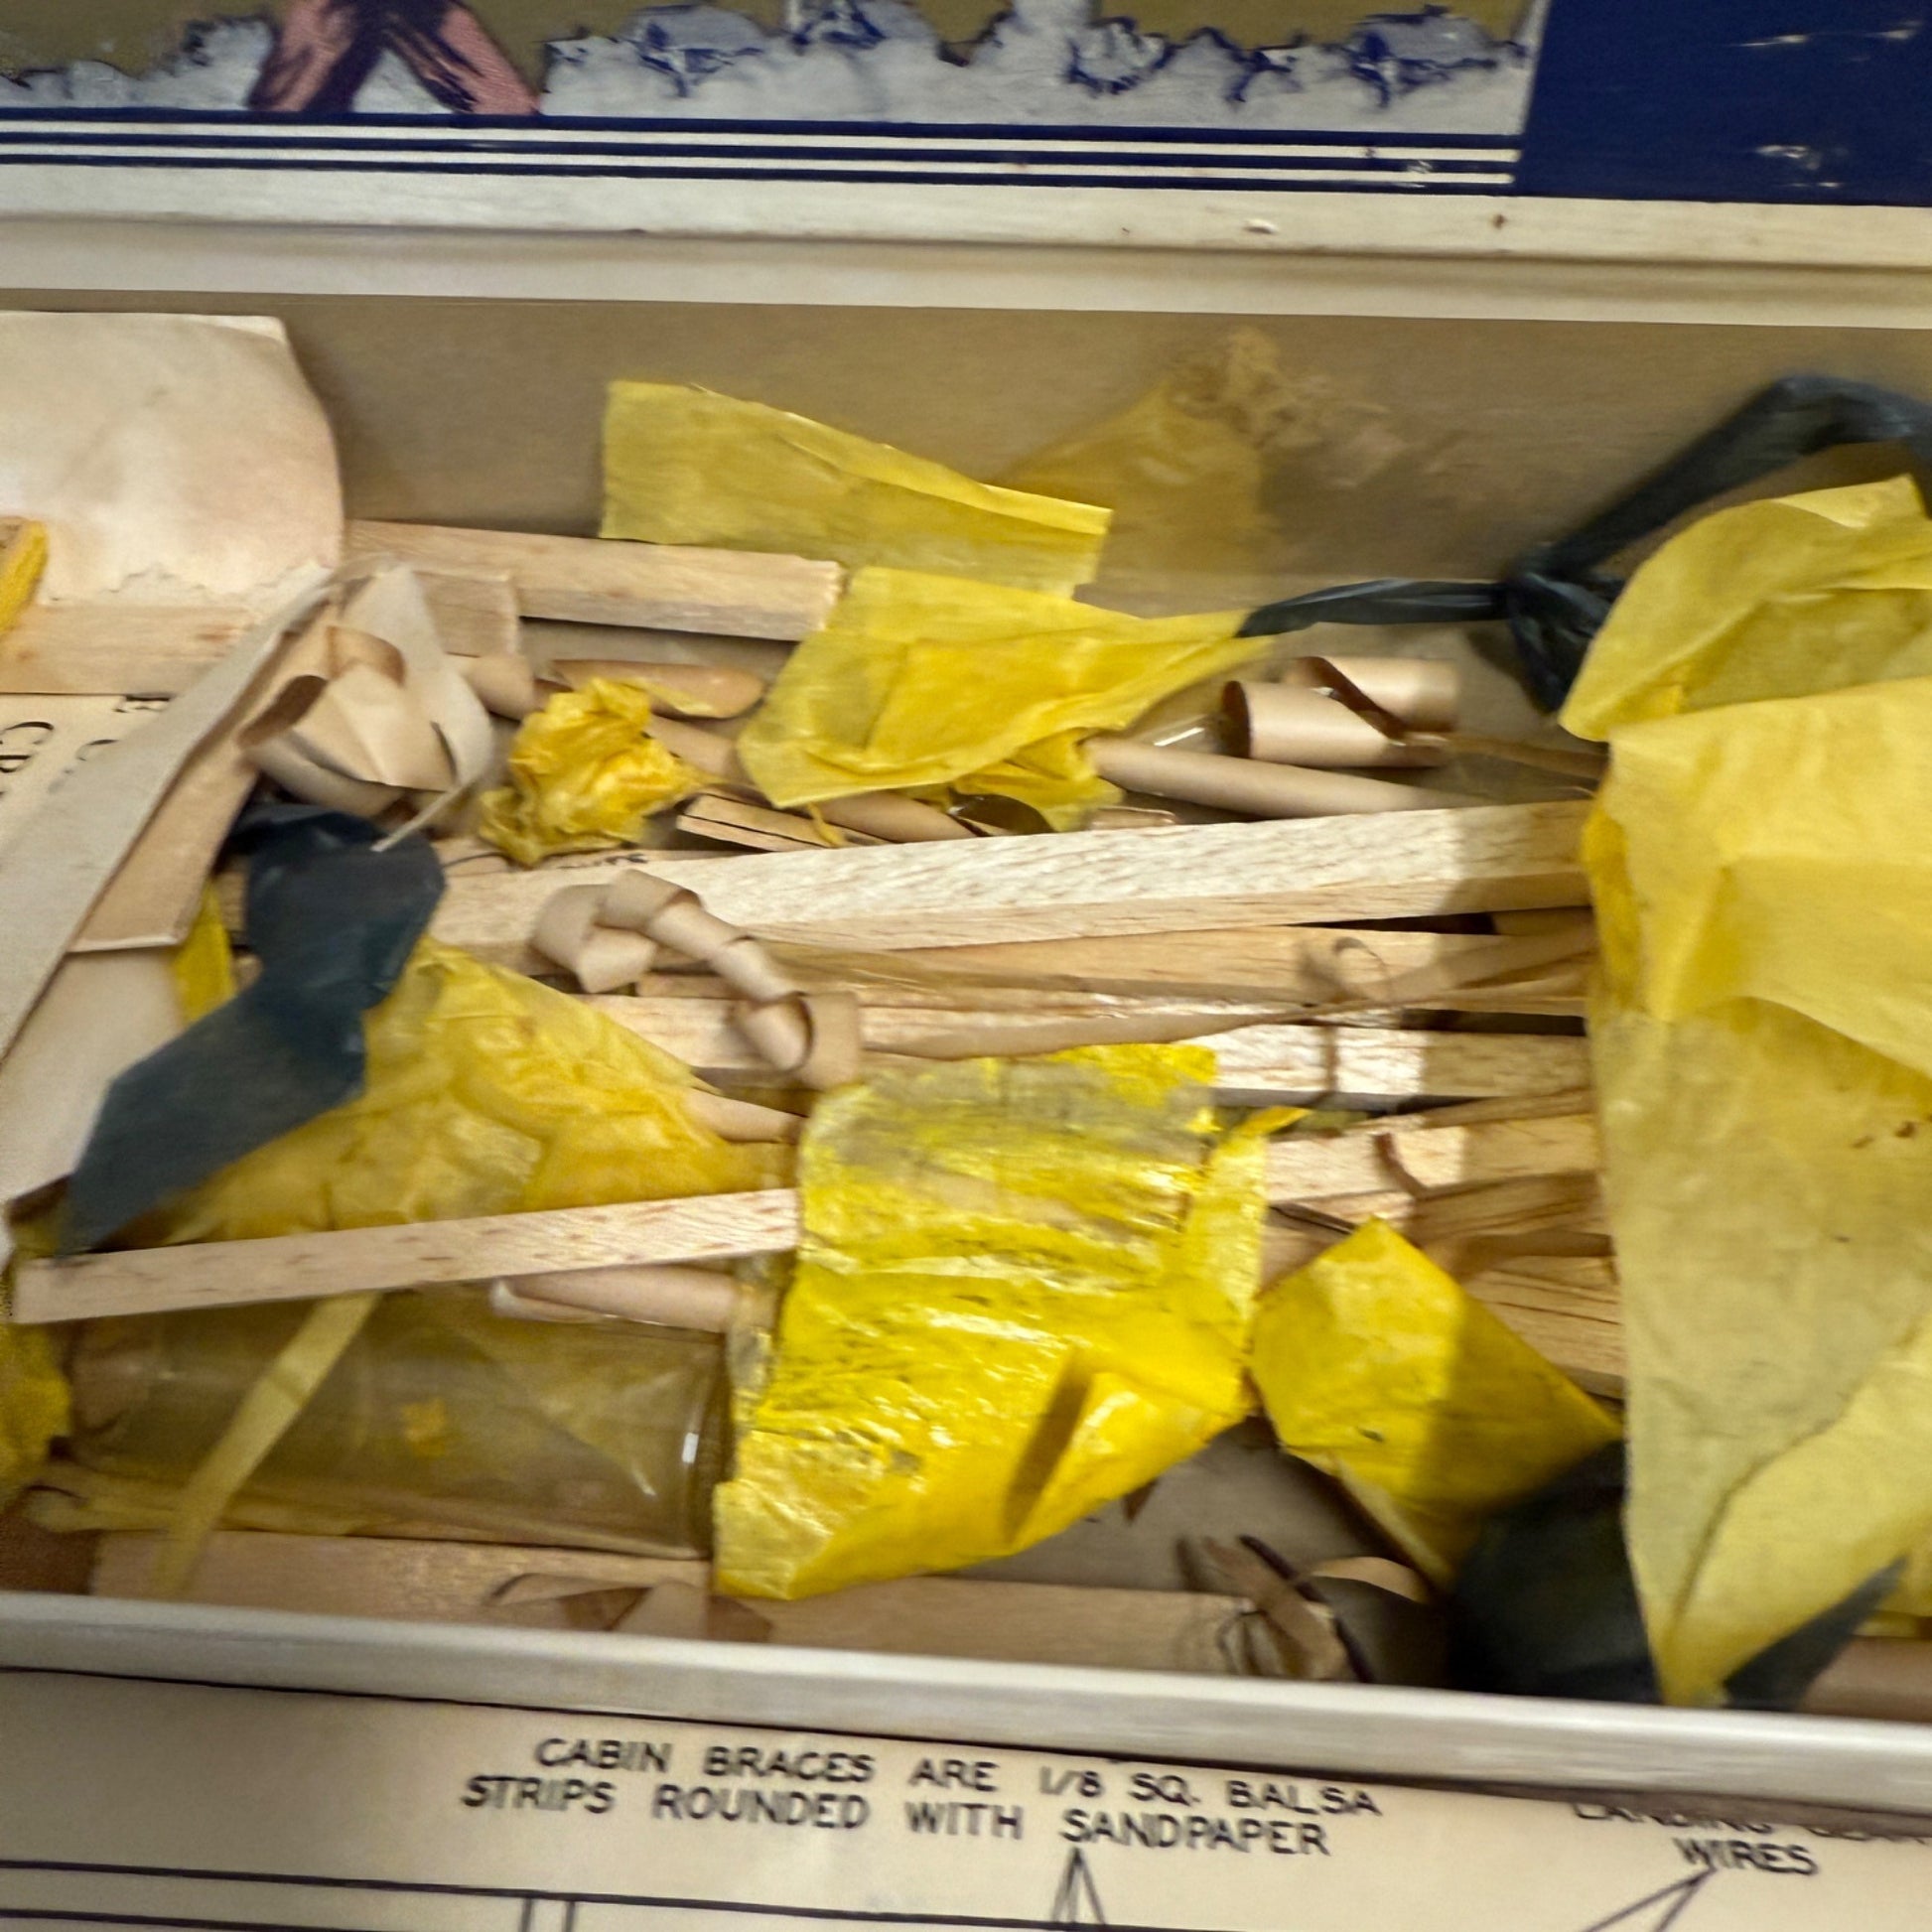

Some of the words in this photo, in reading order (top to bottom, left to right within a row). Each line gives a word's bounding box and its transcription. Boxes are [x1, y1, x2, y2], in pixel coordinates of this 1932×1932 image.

[462, 1775, 616, 1815] STRIPS
[652, 1784, 870, 1829] ROUNDED
[904, 1801, 1023, 1840] WITH
[1061, 1808, 1331, 1857] SANDPAPER
[536, 1737, 672, 1773] CABIN
[704, 1747, 875, 1782] BRACES
[908, 1759, 999, 1792] ARE
[1226, 1780, 1383, 1817] BALSA
[1672, 1837, 1820, 1875] WIRES
